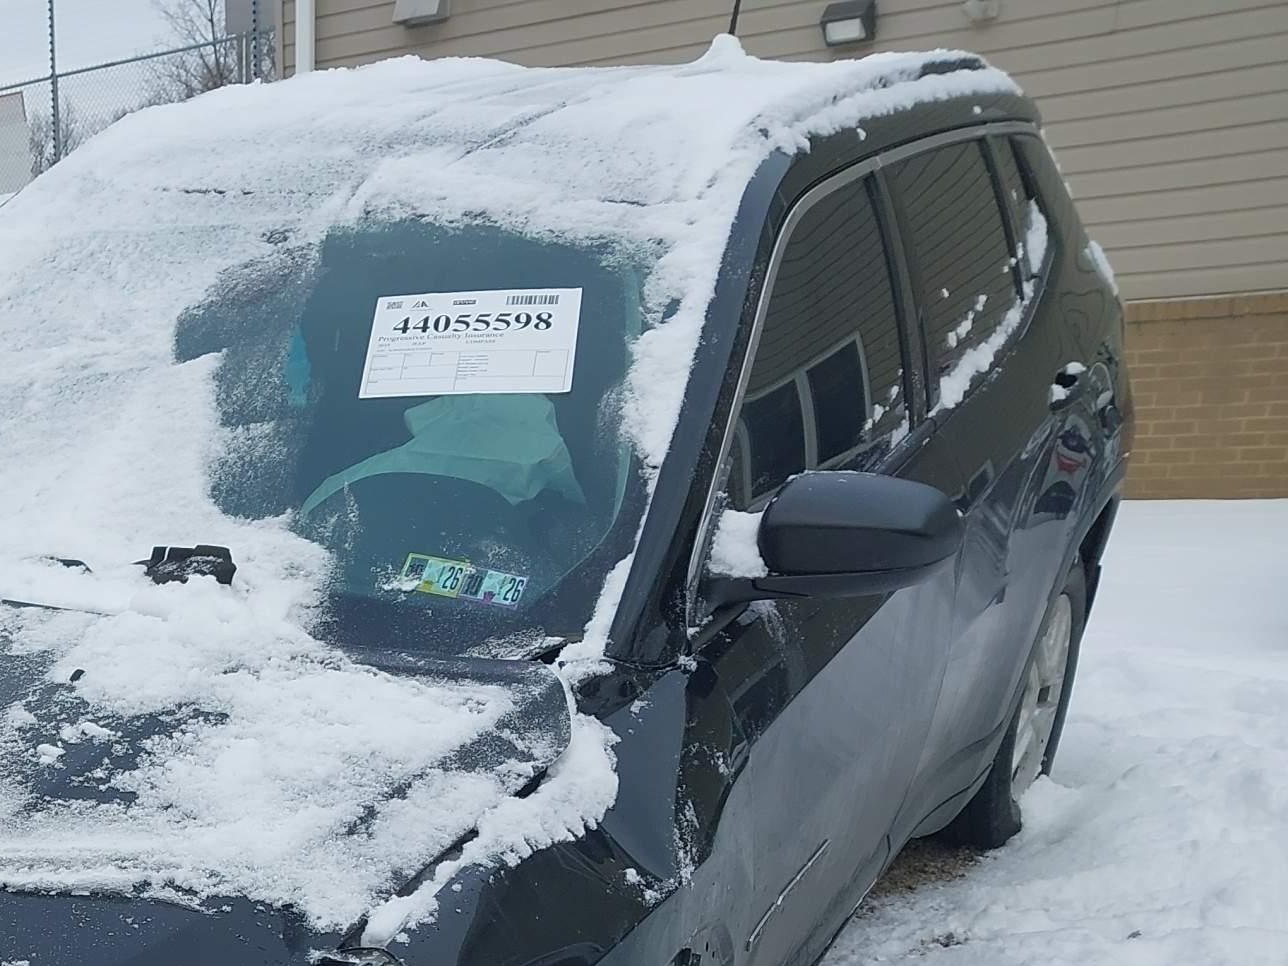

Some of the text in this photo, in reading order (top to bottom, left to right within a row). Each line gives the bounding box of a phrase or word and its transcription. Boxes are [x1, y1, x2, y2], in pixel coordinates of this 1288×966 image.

[393, 311, 554, 334] 44055598
[378, 333, 425, 342] Progressive
[427, 333, 462, 341] Casualty
[442, 566, 463, 590] 26
[503, 578, 525, 602] 26
